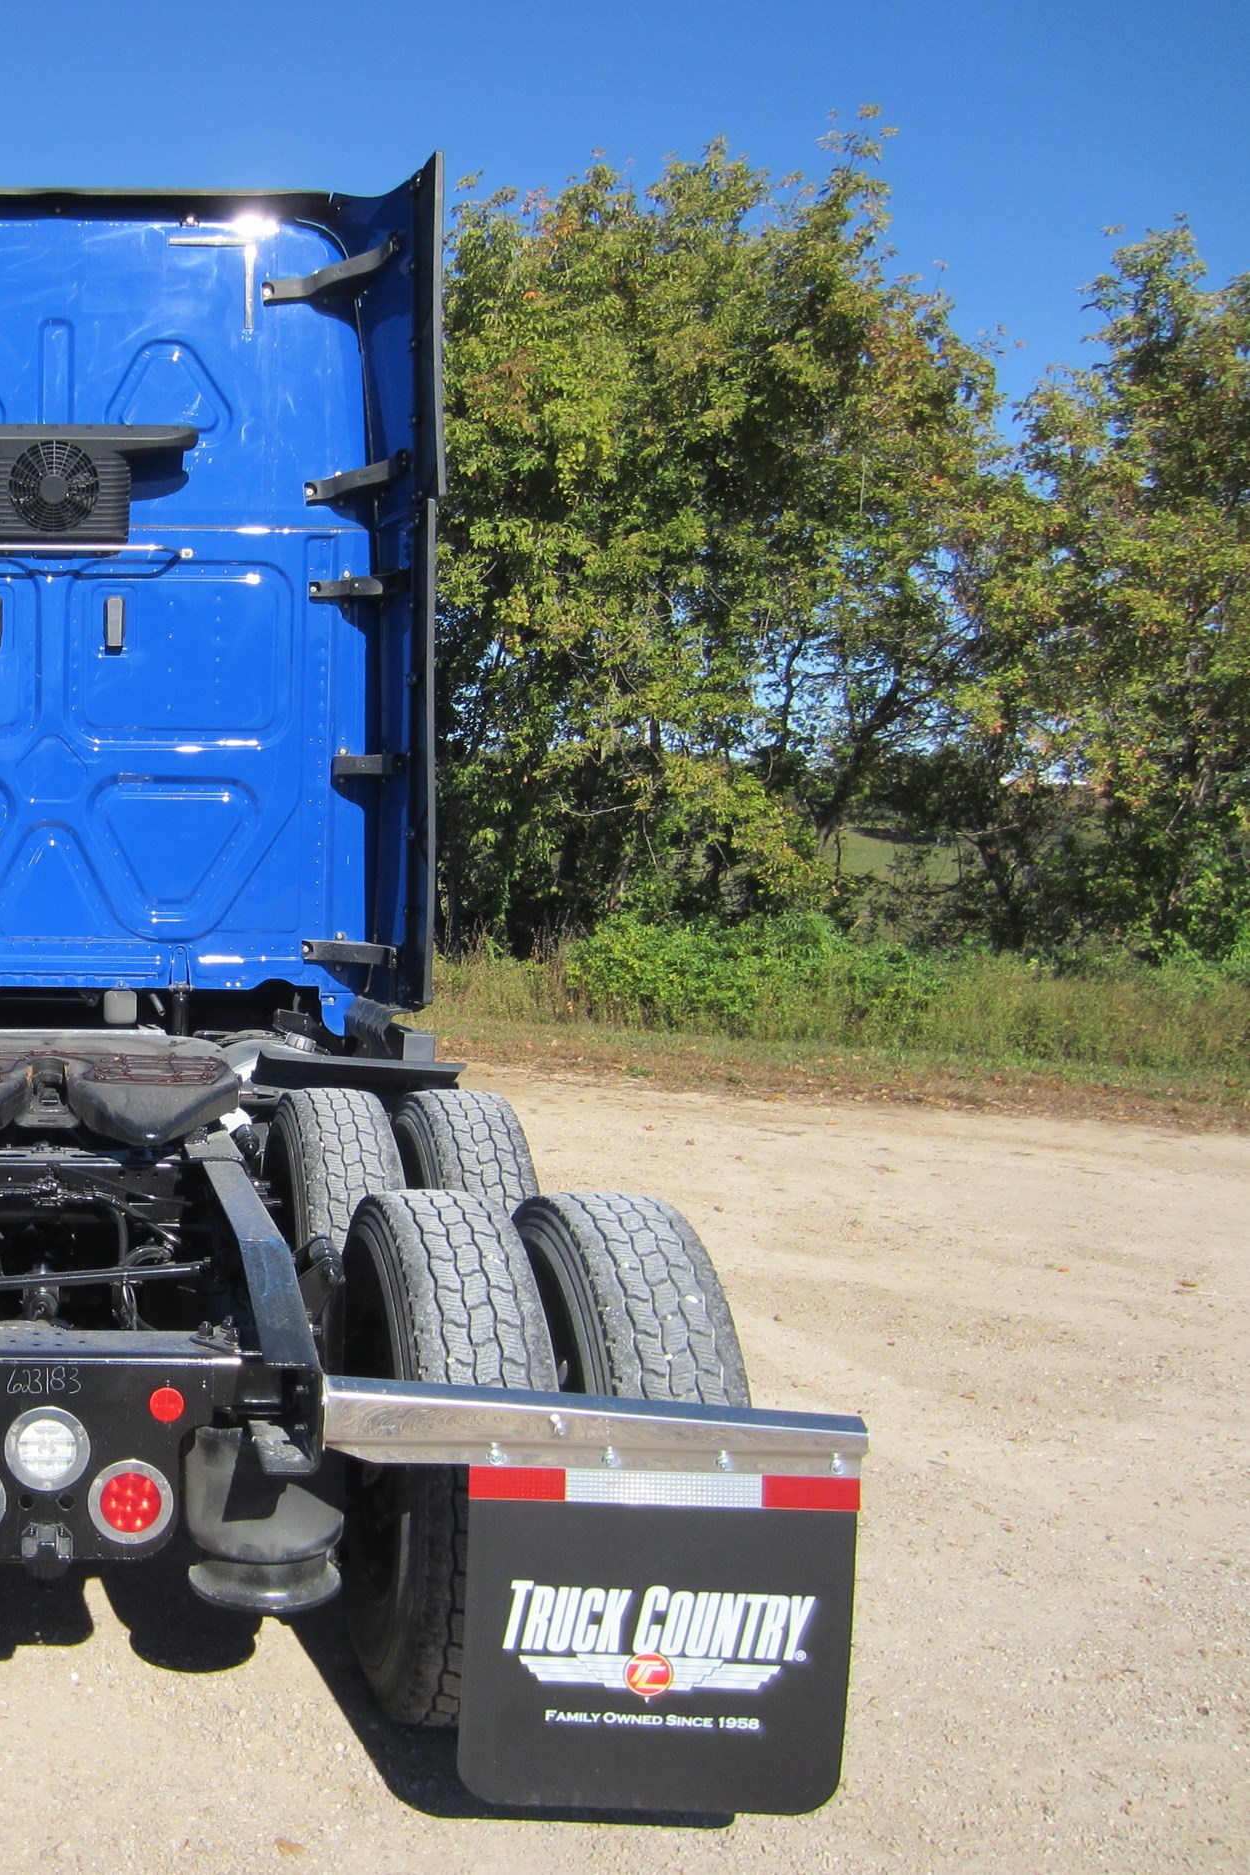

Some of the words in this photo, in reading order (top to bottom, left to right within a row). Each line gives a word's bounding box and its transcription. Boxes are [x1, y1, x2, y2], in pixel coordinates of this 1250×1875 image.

[6, 1365, 82, 1395] 623183
[502, 1579, 632, 1653] TRUCK
[545, 1709, 601, 1723] FAMILY
[602, 1711, 663, 1726] OWNED
[664, 1714, 714, 1728] SINCE
[718, 1716, 760, 1730] 1958
